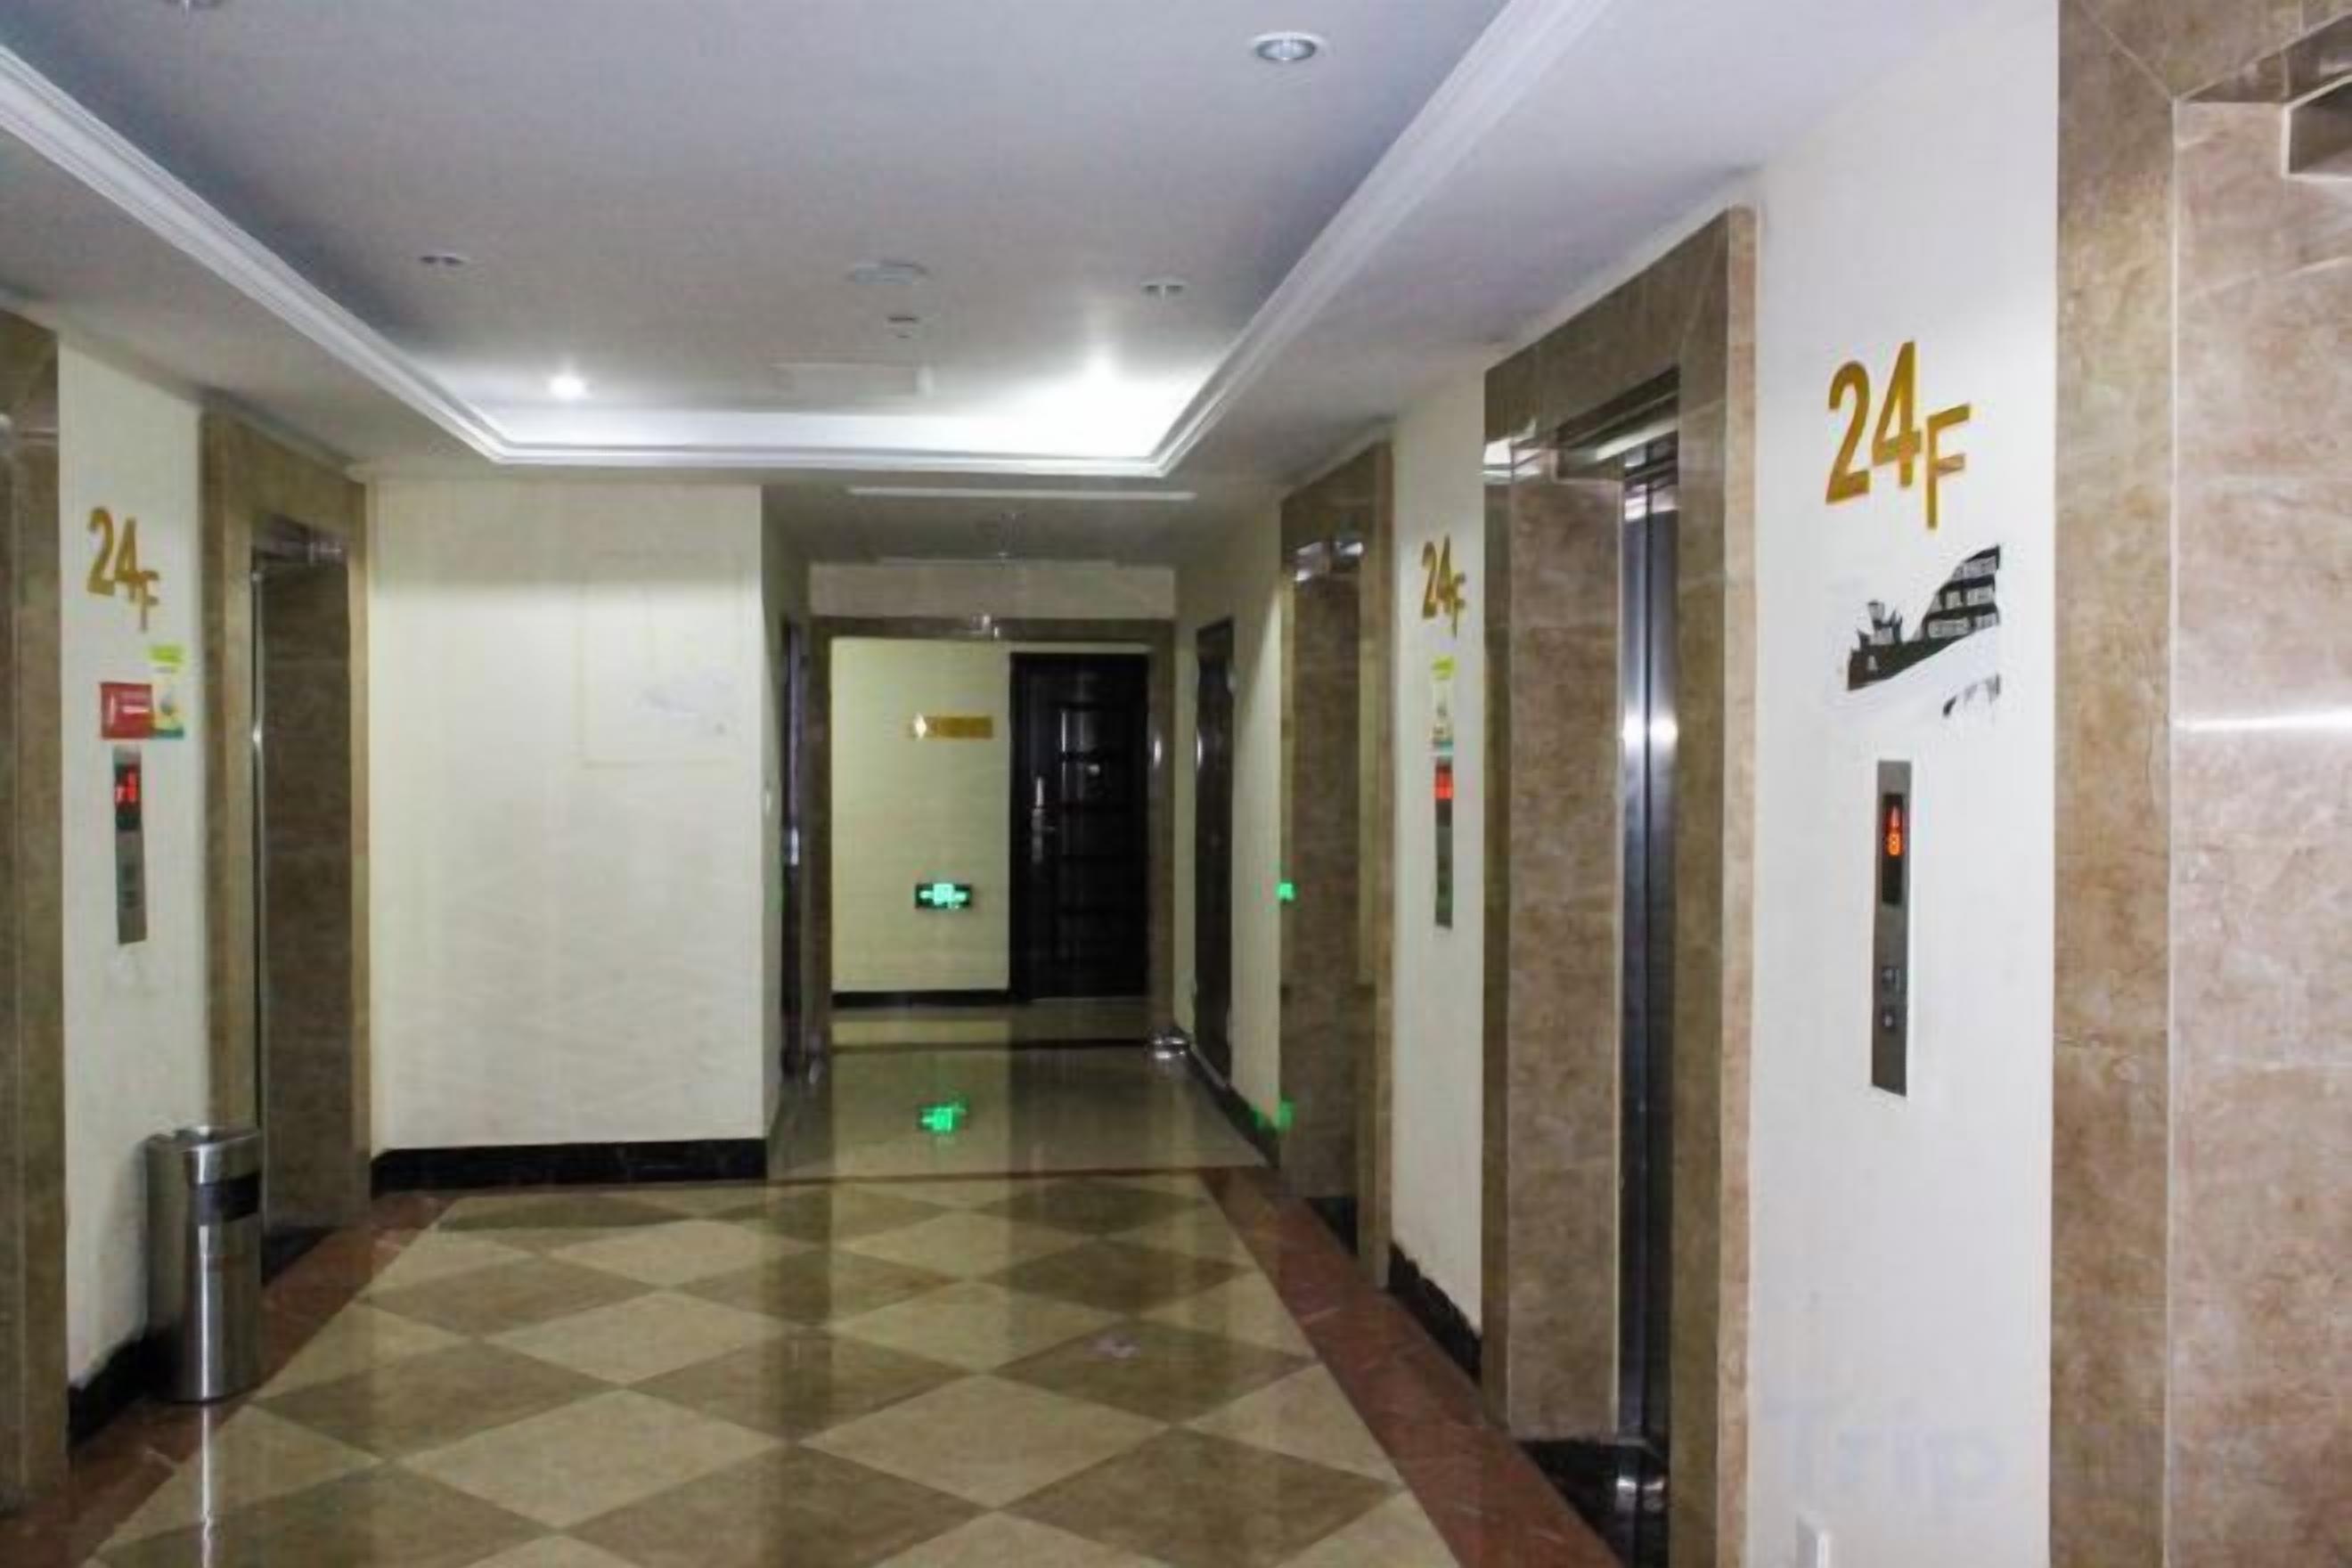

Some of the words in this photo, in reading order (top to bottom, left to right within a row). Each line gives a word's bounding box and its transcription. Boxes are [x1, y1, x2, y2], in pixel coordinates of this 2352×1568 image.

[1827, 340, 1971, 529] 24F
[87, 506, 159, 634] 24F
[1422, 533, 1466, 639] 24F
